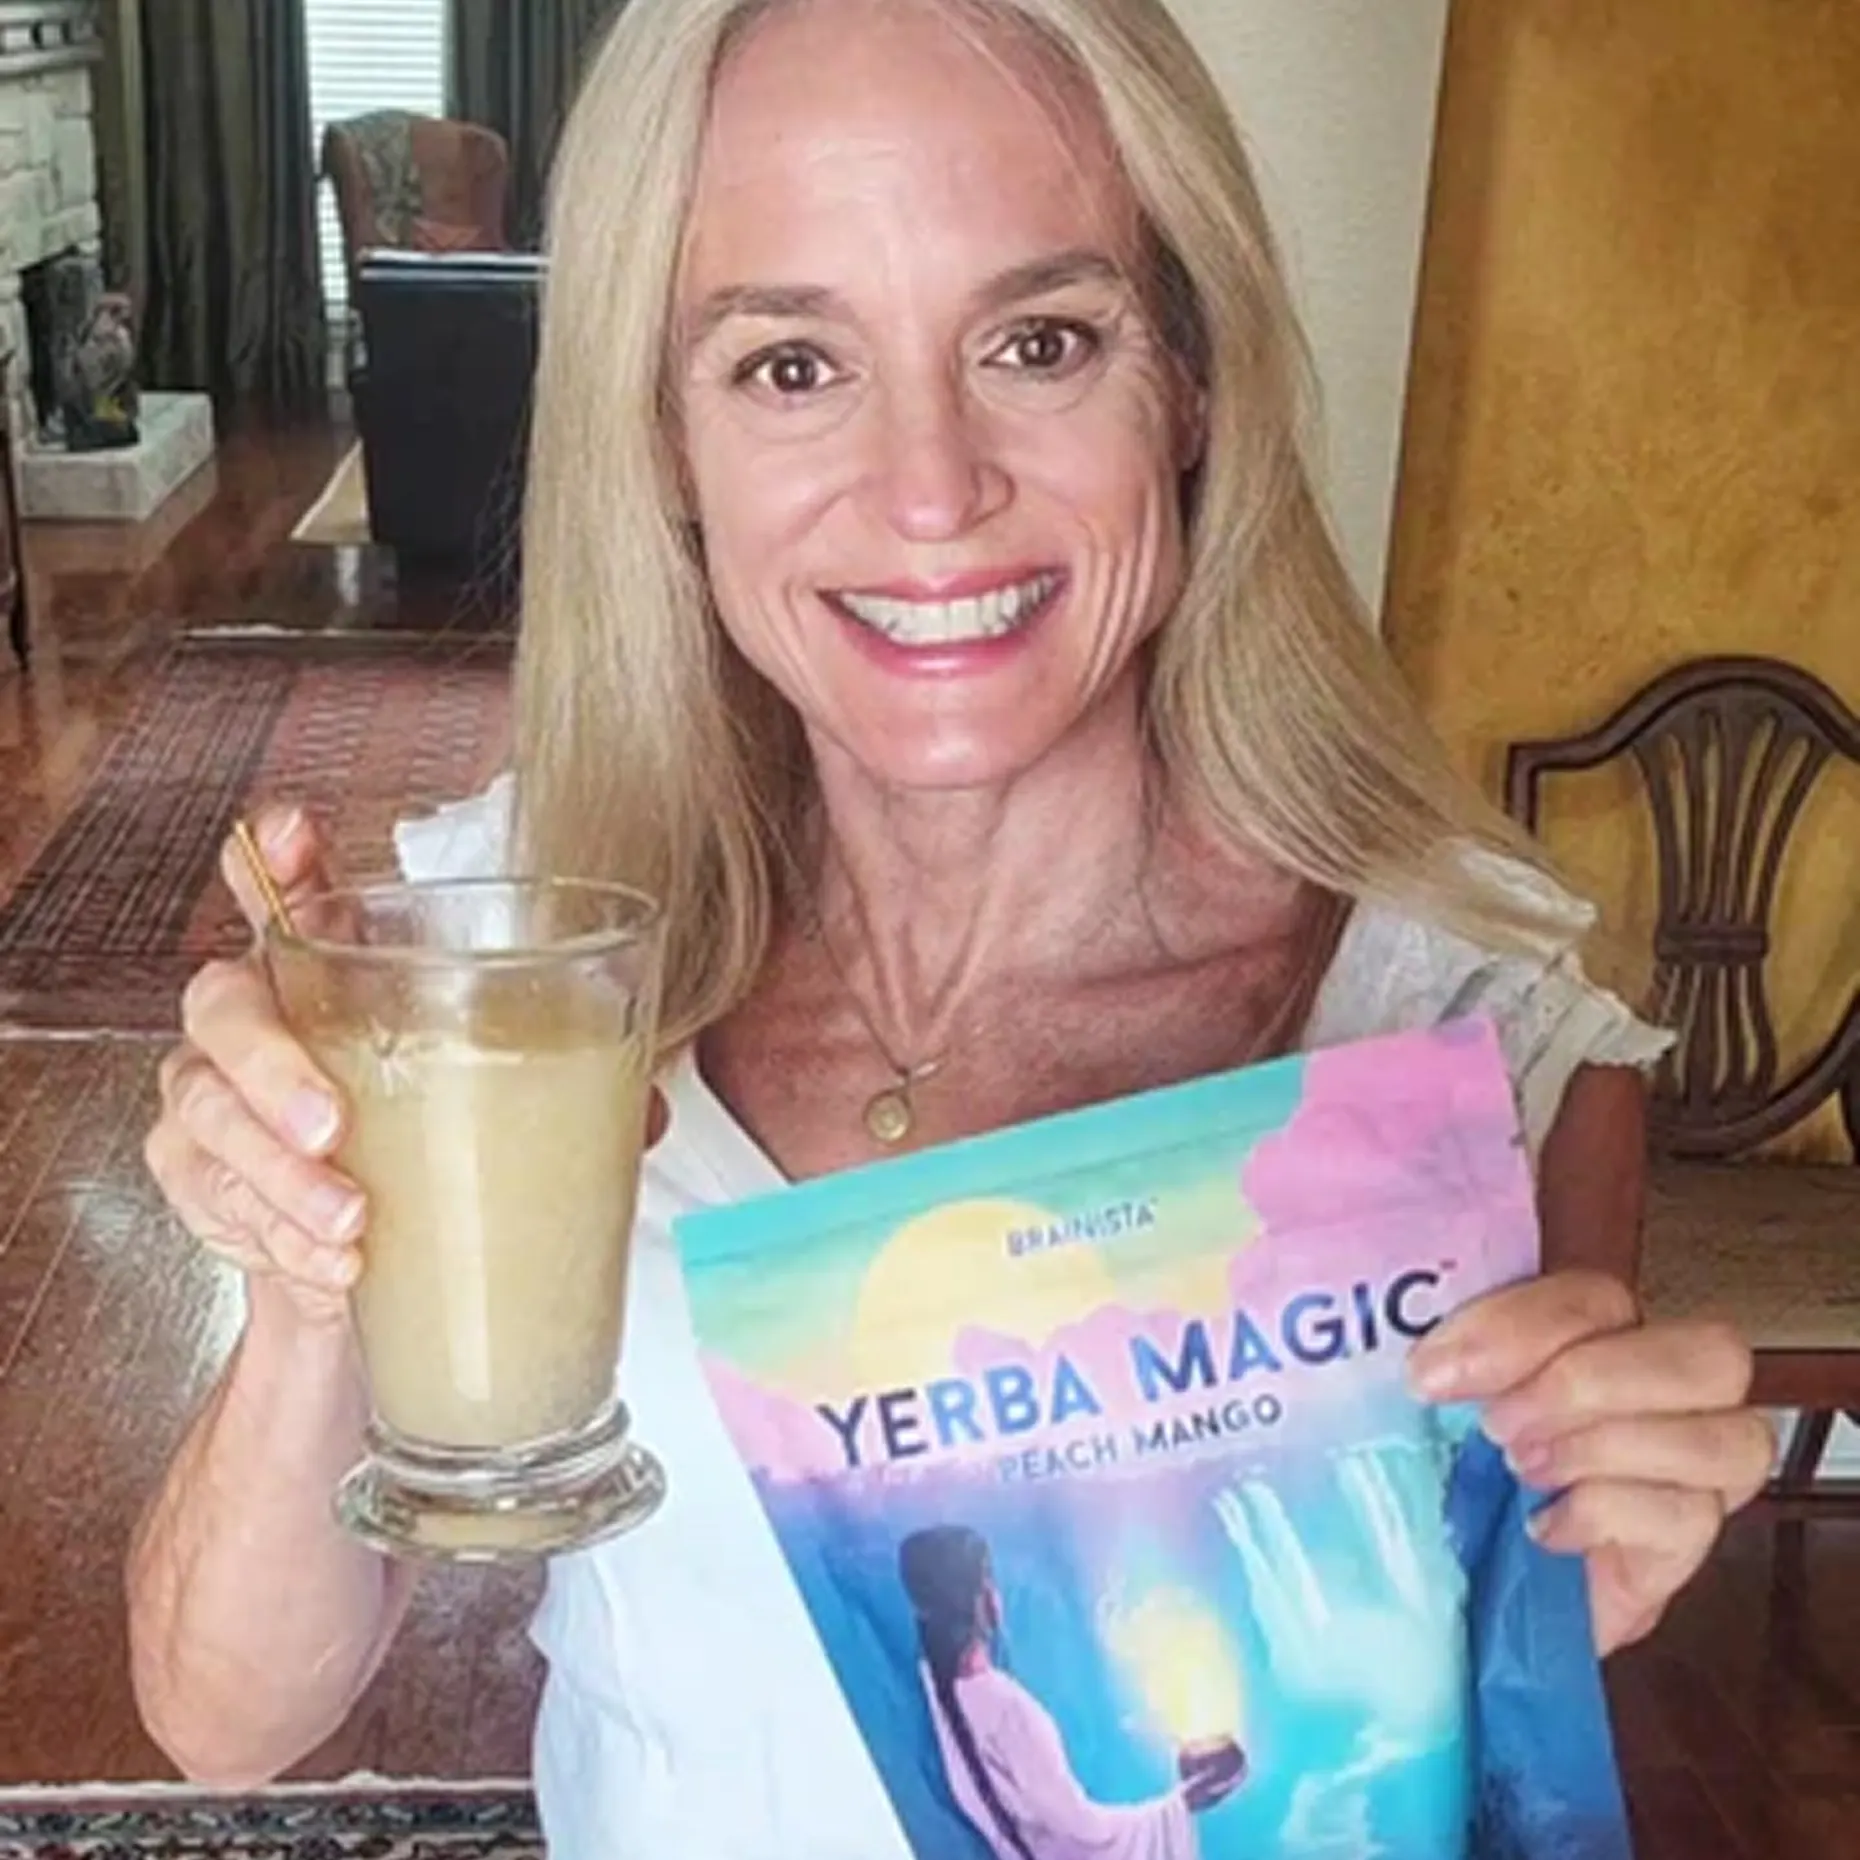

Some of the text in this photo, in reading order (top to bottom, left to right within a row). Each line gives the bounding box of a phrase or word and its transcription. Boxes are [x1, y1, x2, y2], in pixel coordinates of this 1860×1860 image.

[817, 1269, 1442, 1468] YERBA MAGIC
[1001, 1394, 1282, 1484] PEACH MANGO
